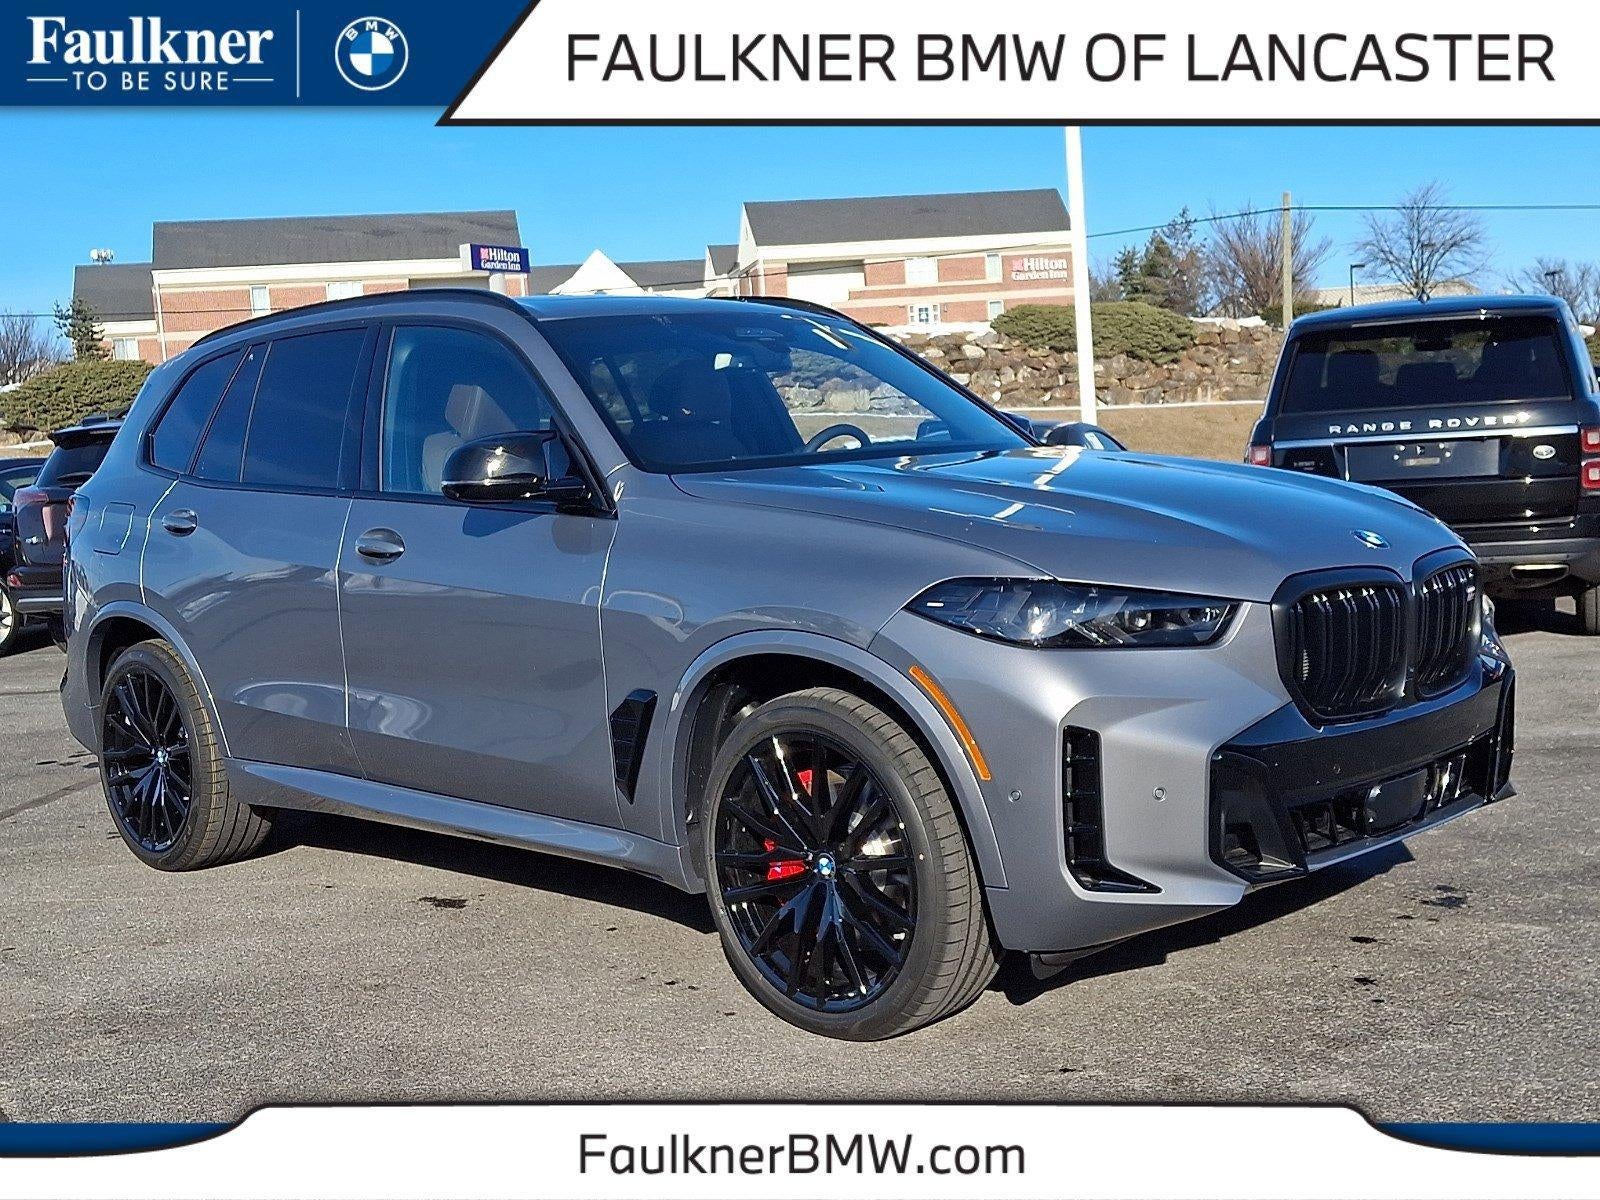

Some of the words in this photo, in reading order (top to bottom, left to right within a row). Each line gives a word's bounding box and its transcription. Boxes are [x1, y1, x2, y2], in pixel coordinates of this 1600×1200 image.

[489, 247, 520, 262] Hilton
[481, 259, 507, 270] Garden
[508, 261, 521, 271] Inn
[1023, 257, 1067, 272] Hilton
[1011, 270, 1049, 281] Garden
[1049, 270, 1067, 279] Inn
[1328, 421, 1412, 434] RANGE
[1428, 414, 1519, 428] ROVER
